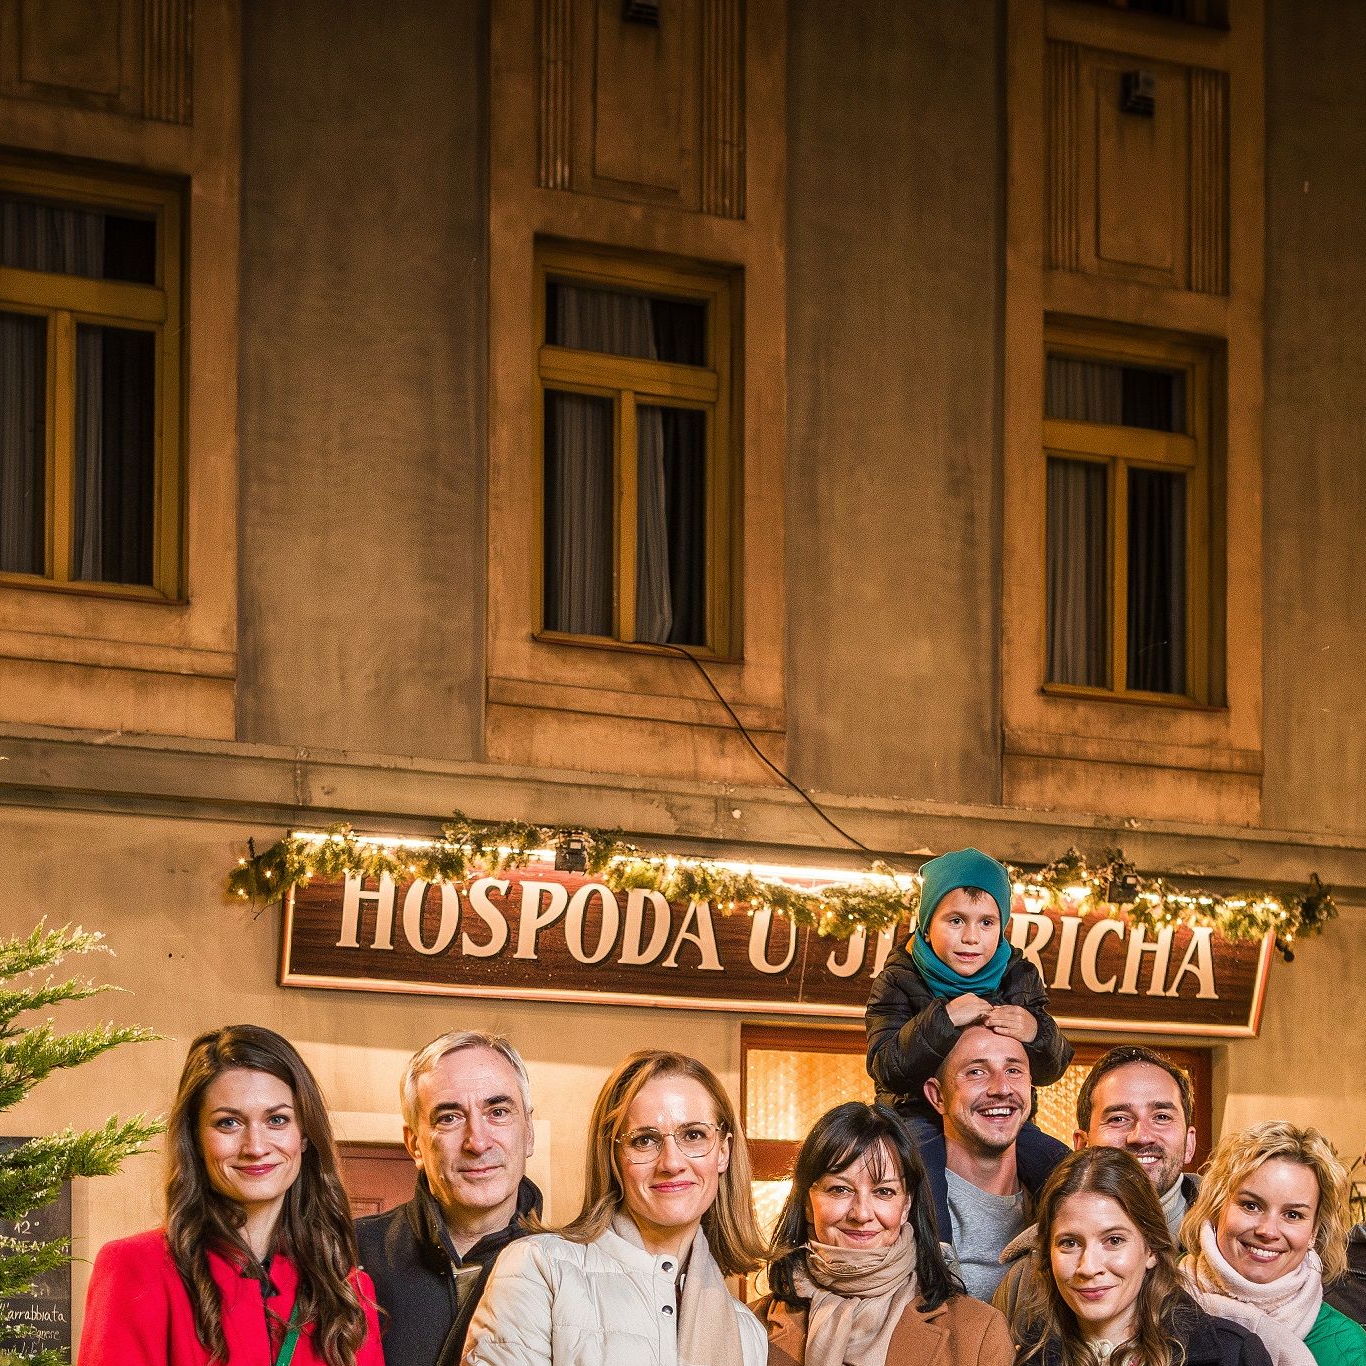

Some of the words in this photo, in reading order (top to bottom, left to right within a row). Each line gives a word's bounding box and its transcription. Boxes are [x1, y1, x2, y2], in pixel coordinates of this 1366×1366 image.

[335, 868, 725, 972] HOSPODA
[747, 909, 798, 975] U
[826, 897, 1220, 1000] JIŘICHA
